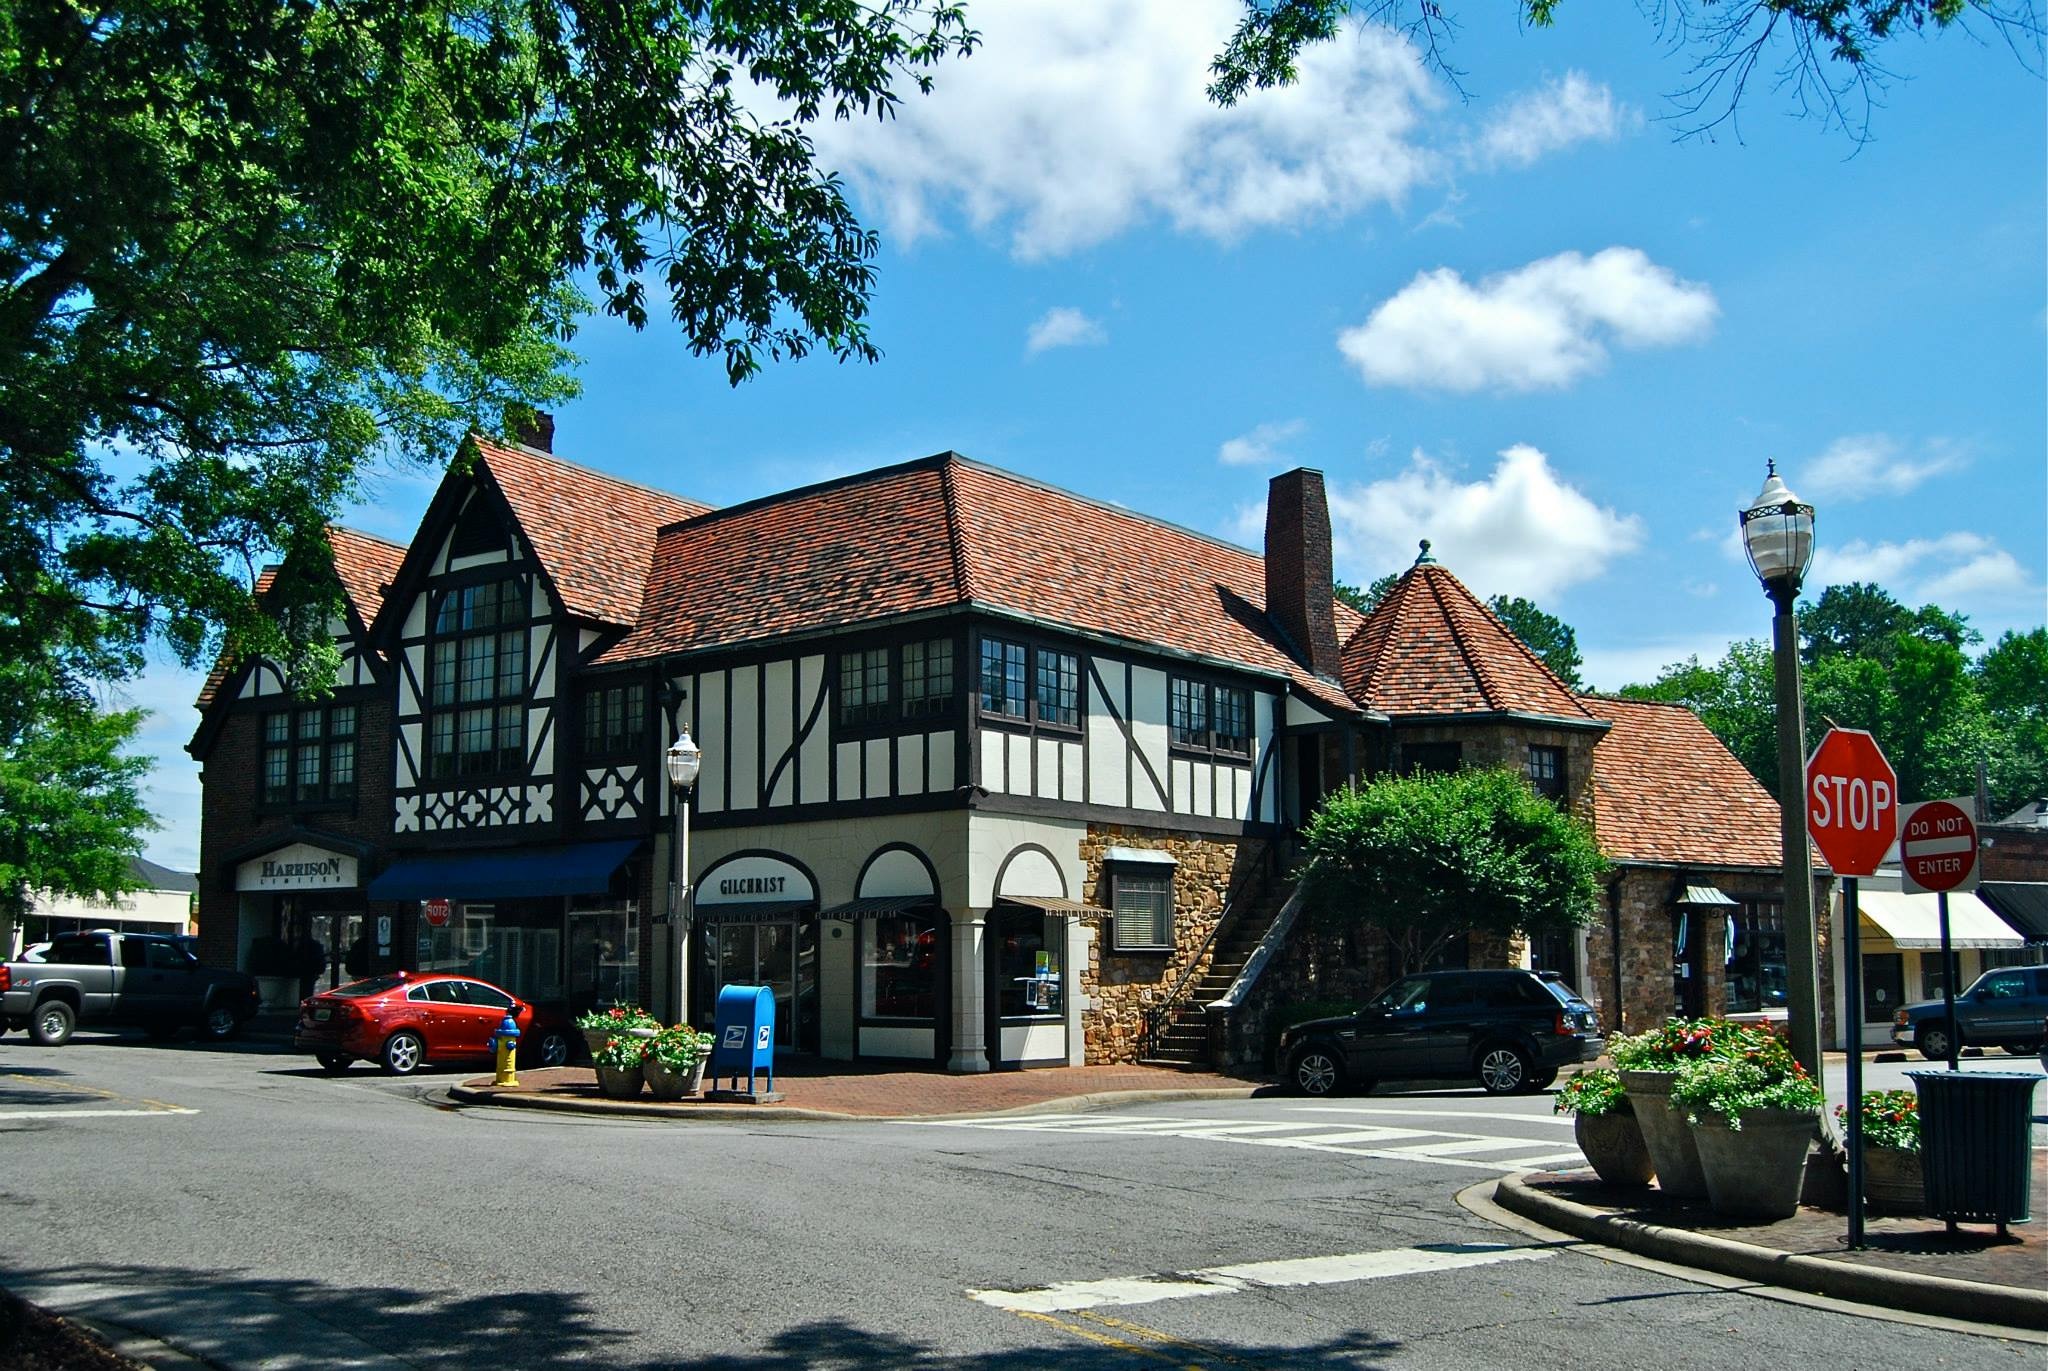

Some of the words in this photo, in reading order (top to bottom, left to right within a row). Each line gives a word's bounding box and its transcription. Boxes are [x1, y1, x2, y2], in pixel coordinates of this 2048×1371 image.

[1812, 774, 1891, 831] STOP
[1910, 821, 1929, 836] DO
[1936, 817, 1964, 833] NOT
[261, 858, 341, 877] HARRISON
[1918, 857, 1961, 875] ENTER
[720, 876, 785, 895] GILCHRIST
